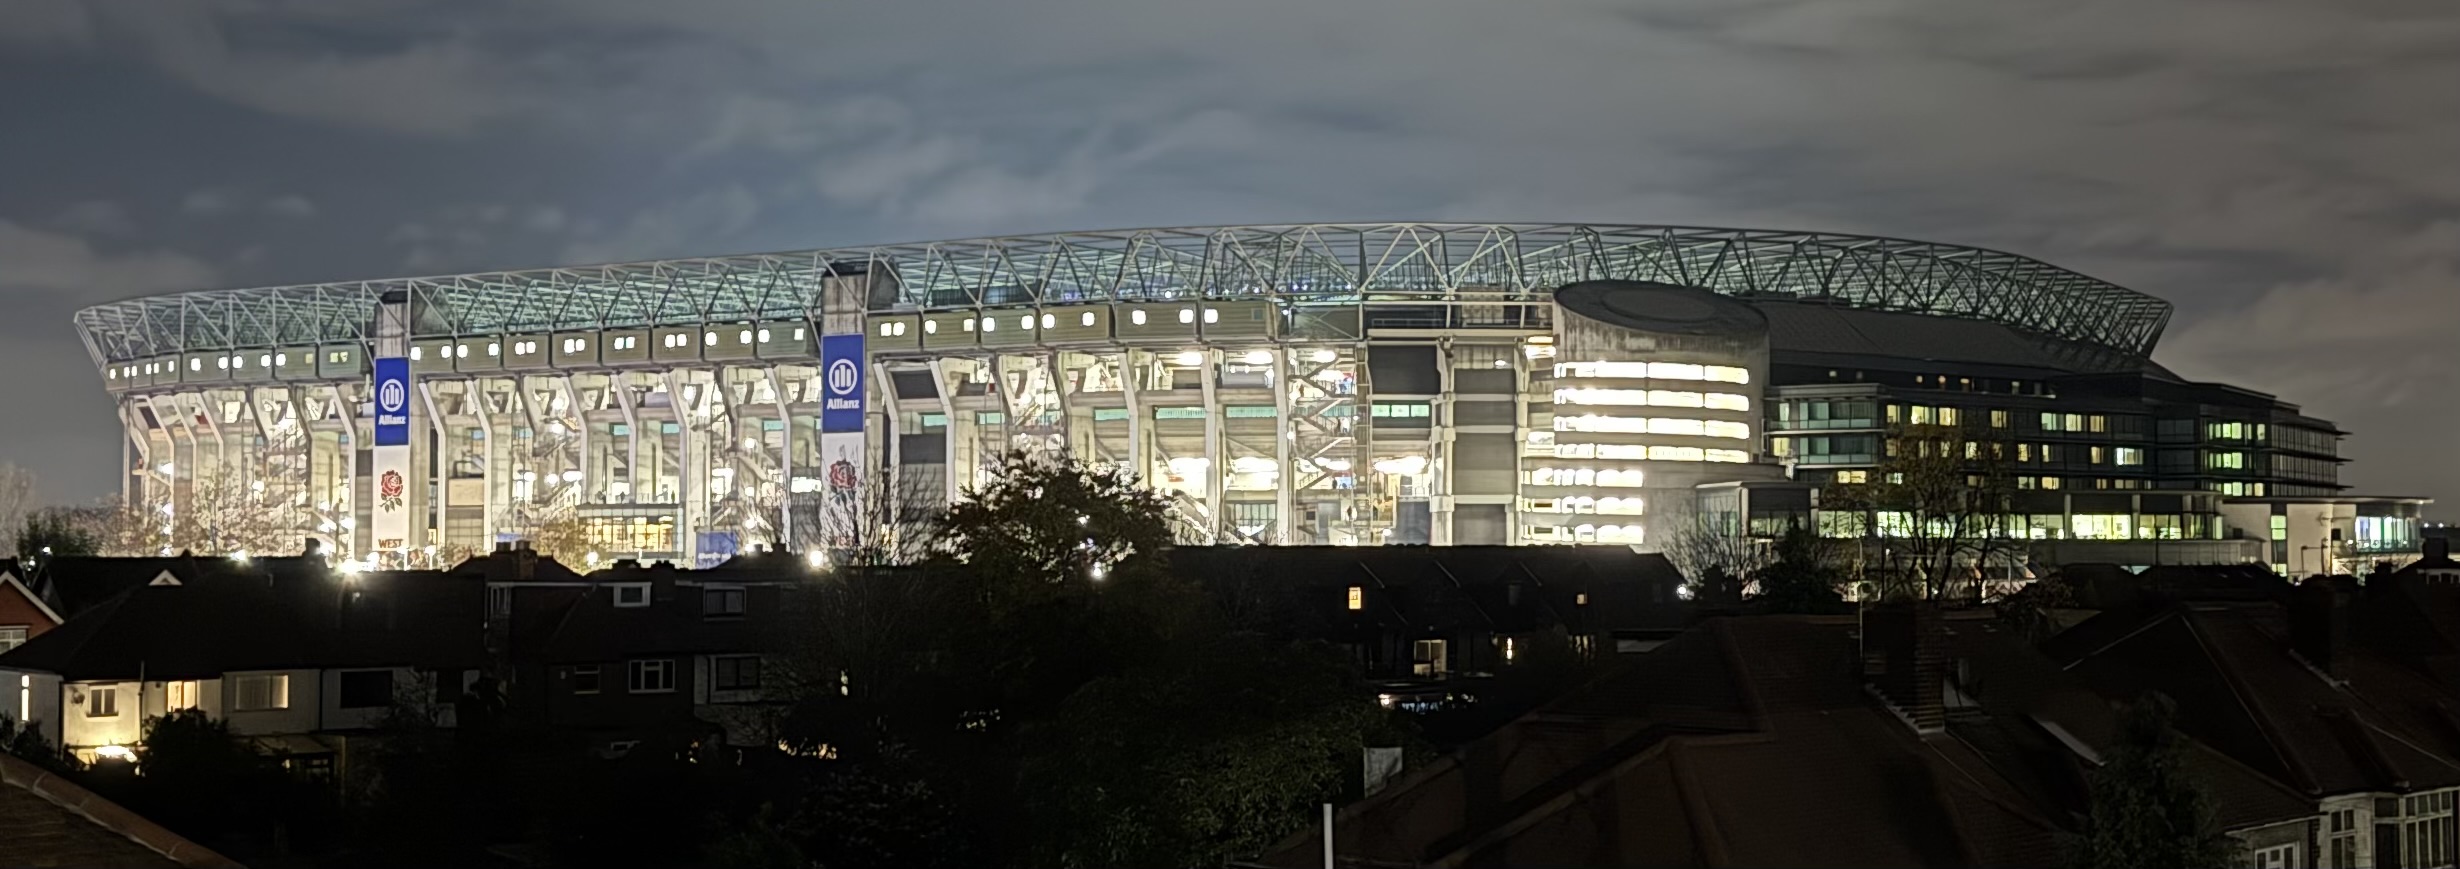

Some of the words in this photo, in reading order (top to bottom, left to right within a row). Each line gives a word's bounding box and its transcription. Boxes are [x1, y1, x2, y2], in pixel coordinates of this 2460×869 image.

[827, 398, 860, 410] Allianz
[378, 414, 407, 426] Allianz
[378, 538, 403, 549] WEST
